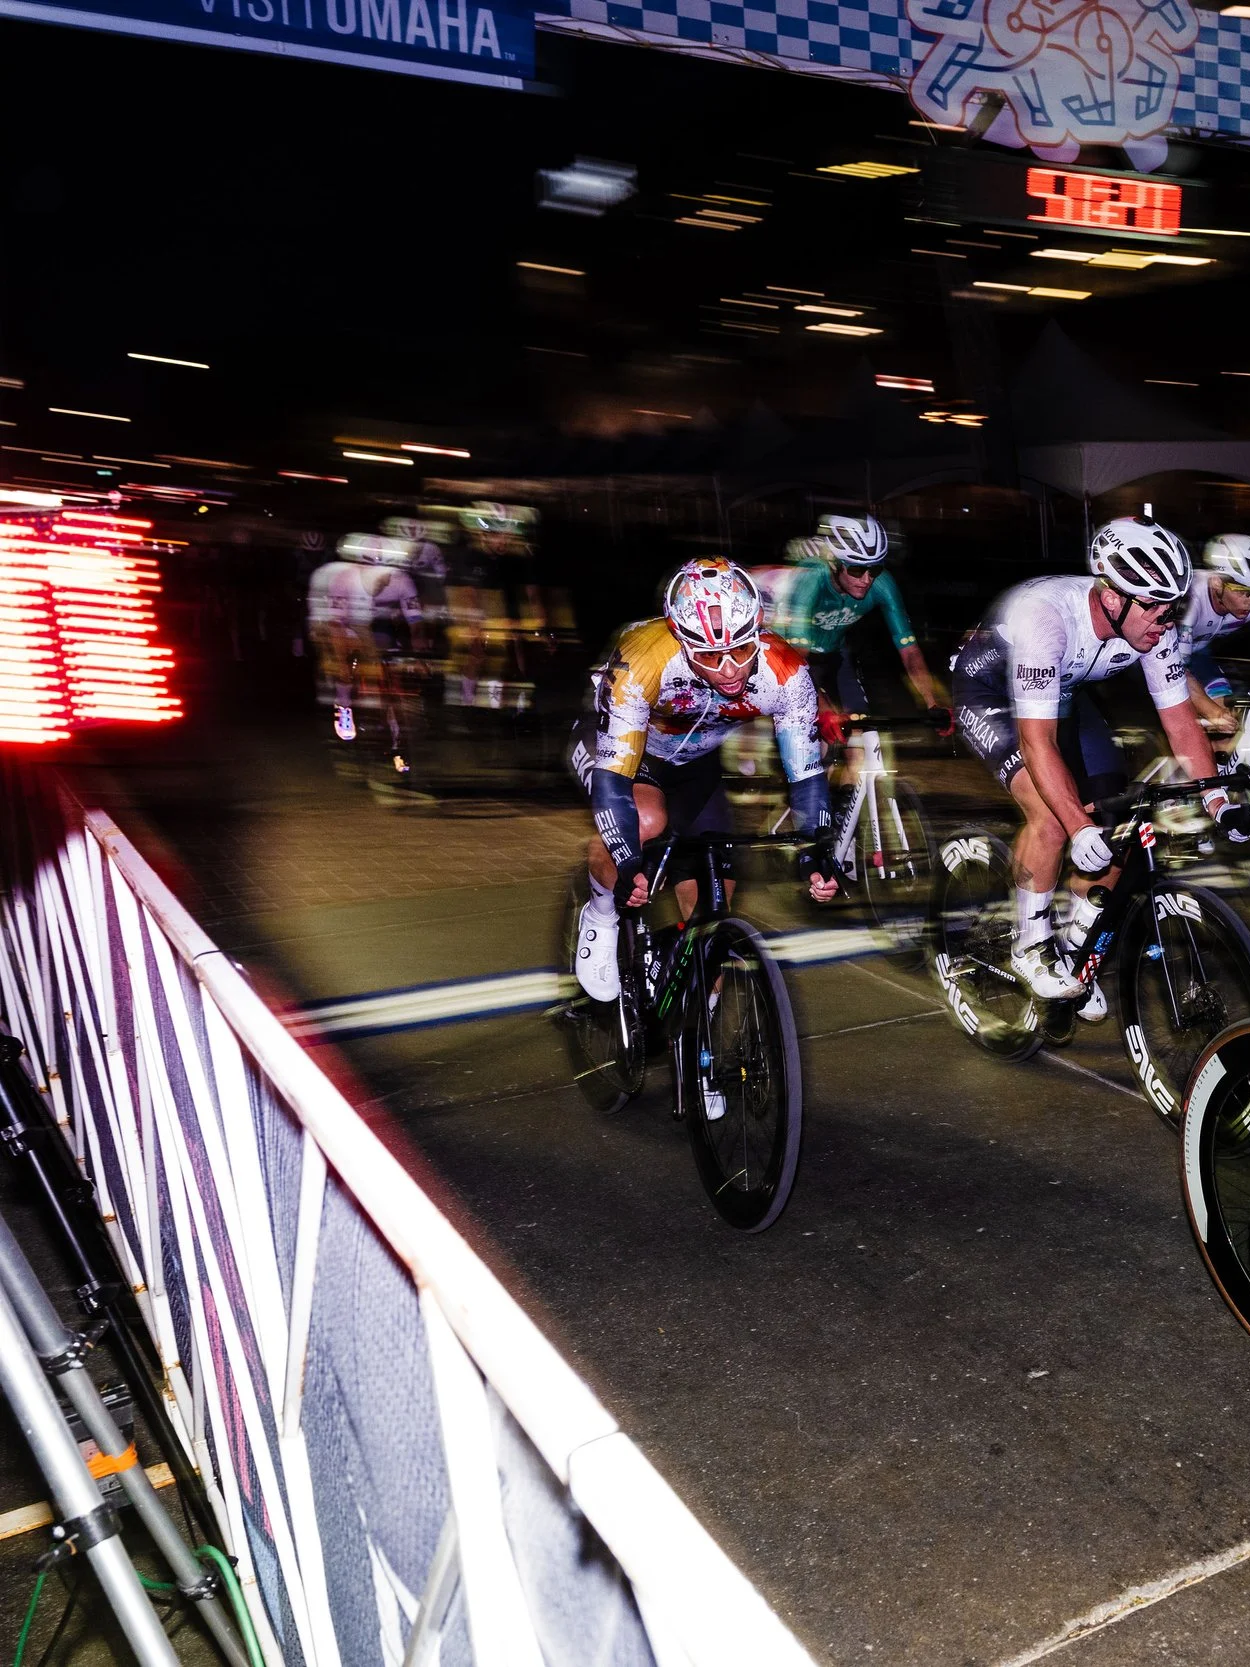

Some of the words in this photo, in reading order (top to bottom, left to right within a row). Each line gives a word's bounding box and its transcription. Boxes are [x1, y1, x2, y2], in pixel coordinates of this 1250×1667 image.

[965, 656, 984, 678] GEMS
[984, 648, 1001, 665] NOTE
[1016, 664, 1056, 681] Ripped
[959, 705, 999, 754] LIPMAN
[987, 965, 1016, 983] SRAM
